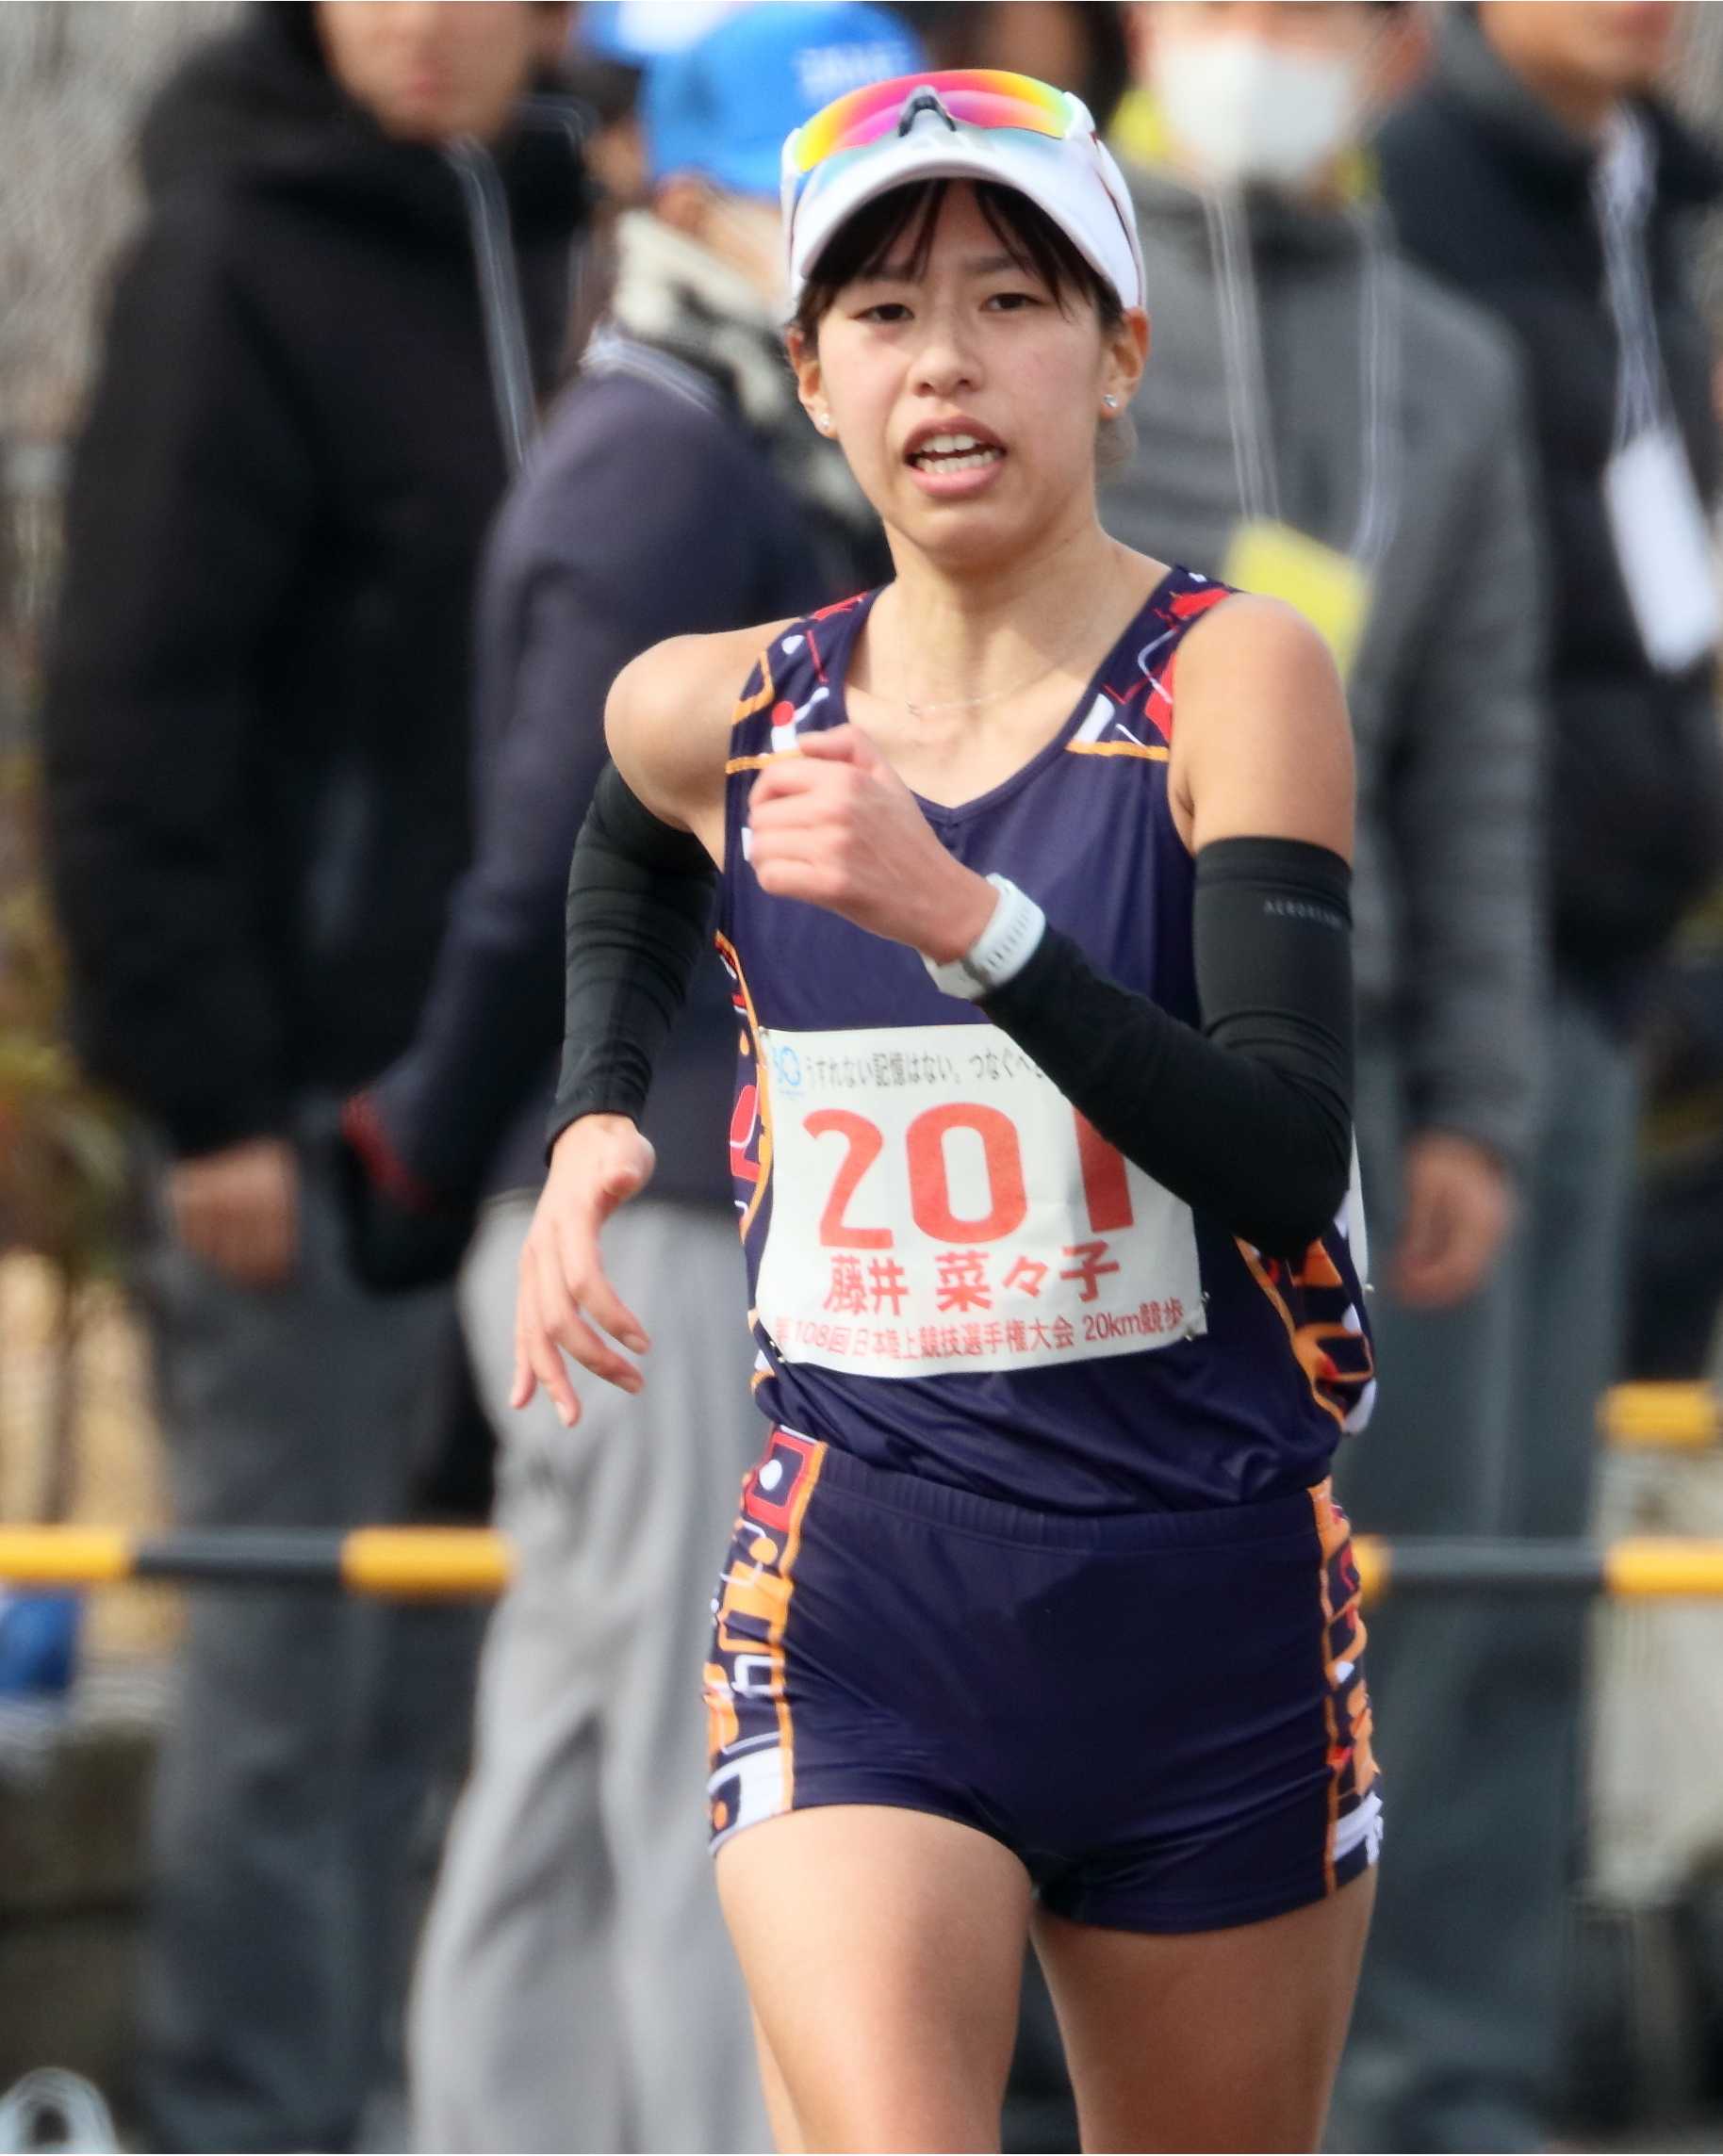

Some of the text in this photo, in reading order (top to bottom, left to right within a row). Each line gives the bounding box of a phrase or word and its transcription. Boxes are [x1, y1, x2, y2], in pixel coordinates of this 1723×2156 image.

[802, 1102, 1135, 1250] 201
[823, 1240, 1121, 1316] 藤井 菜々子
[1082, 1297, 1184, 1342] 20km競歩
